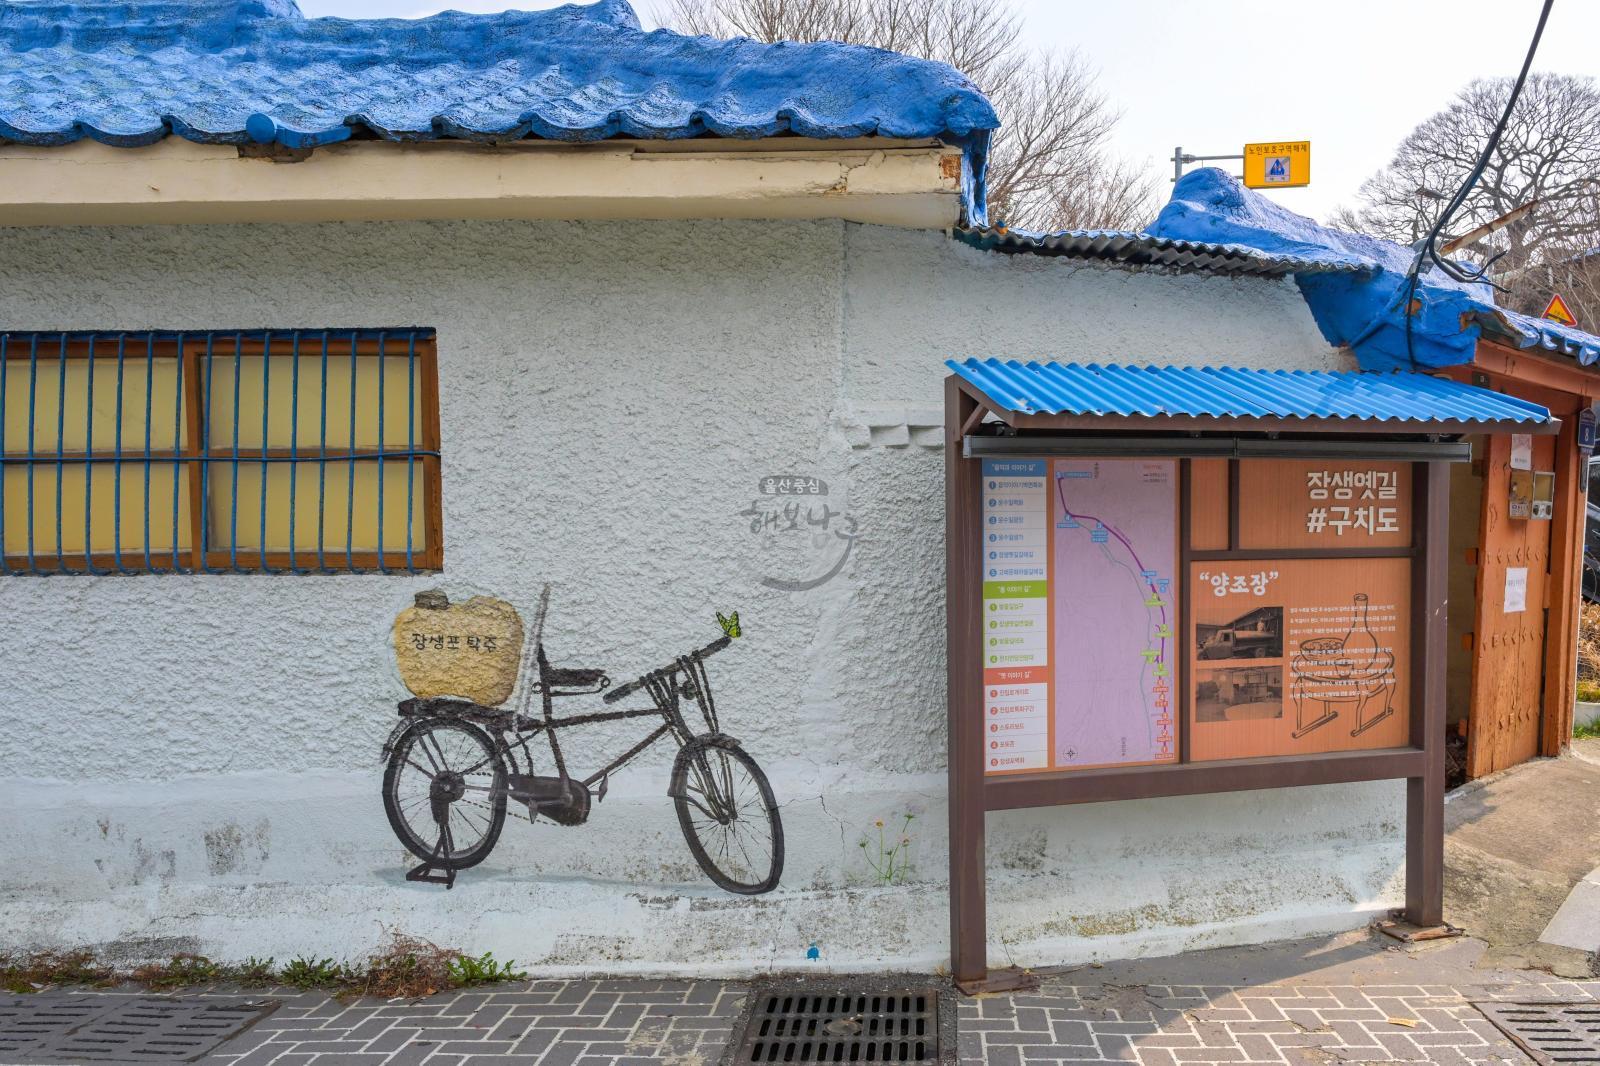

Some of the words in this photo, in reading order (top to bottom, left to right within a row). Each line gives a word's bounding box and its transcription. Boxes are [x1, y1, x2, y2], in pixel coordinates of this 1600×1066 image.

[1307, 471, 1397, 500] 장생옛길
[1307, 506, 1400, 536] #구치도
[412, 633, 460, 651] 장생포
[467, 635, 497, 653] 탁주
